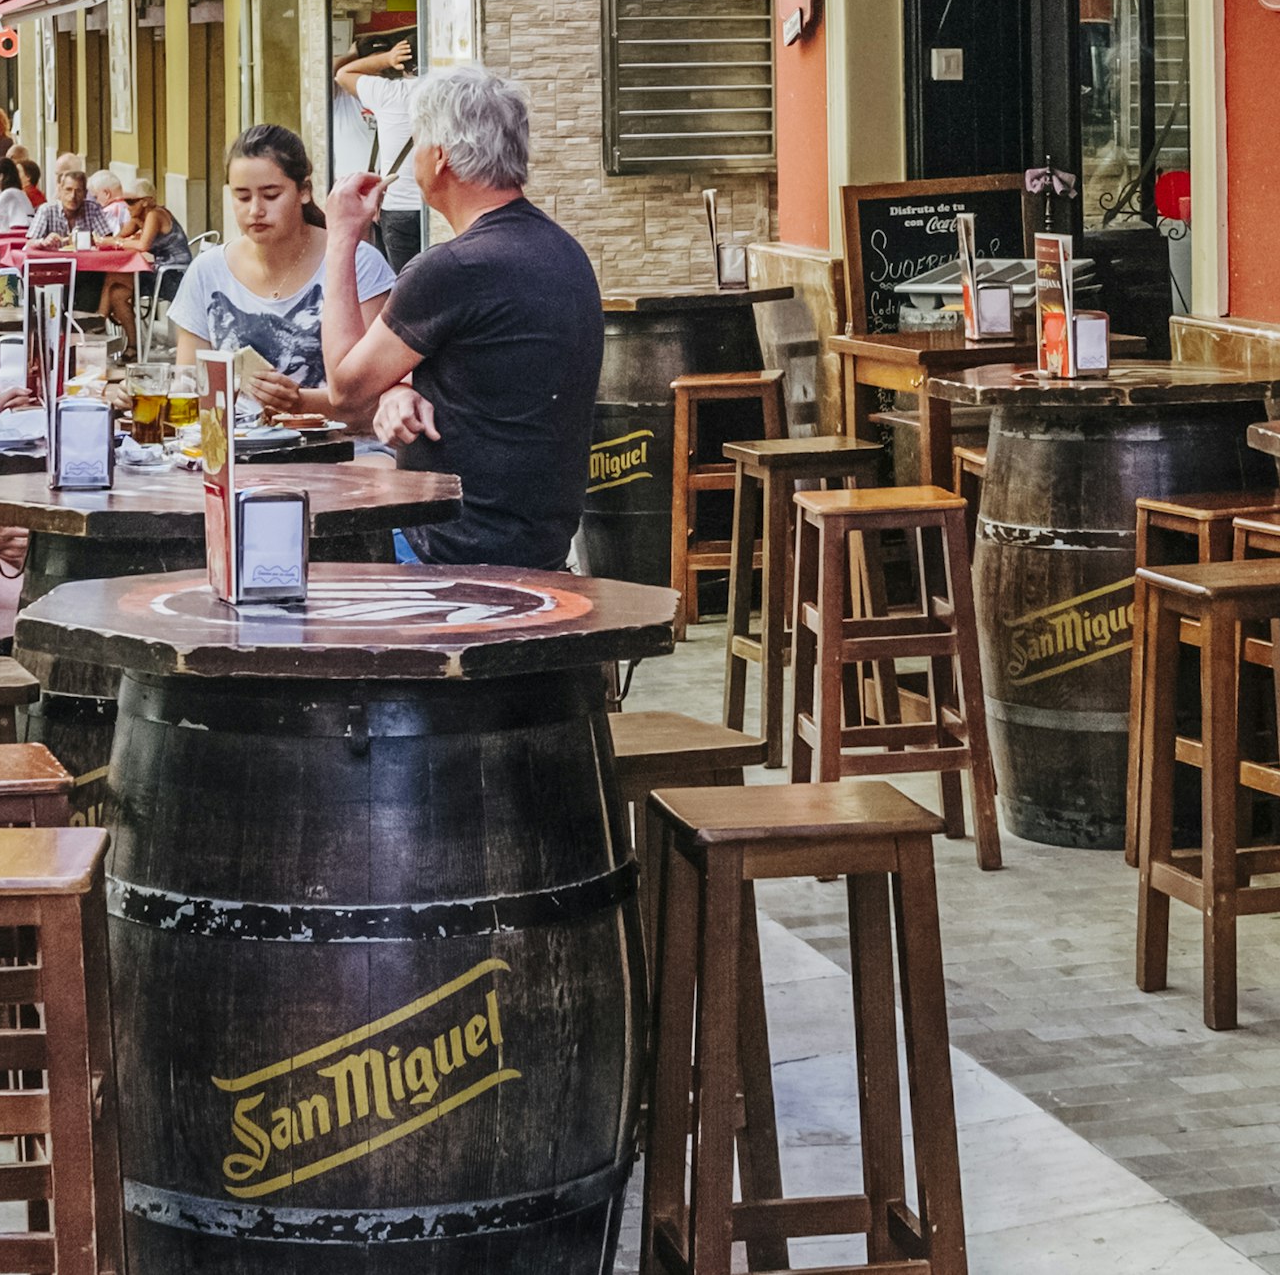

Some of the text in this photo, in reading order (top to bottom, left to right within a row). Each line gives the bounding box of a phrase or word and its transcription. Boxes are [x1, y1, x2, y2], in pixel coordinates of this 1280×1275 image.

[889, 206, 936, 216] Disfruta
[937, 204, 951, 212] de
[904, 219, 924, 227] con
